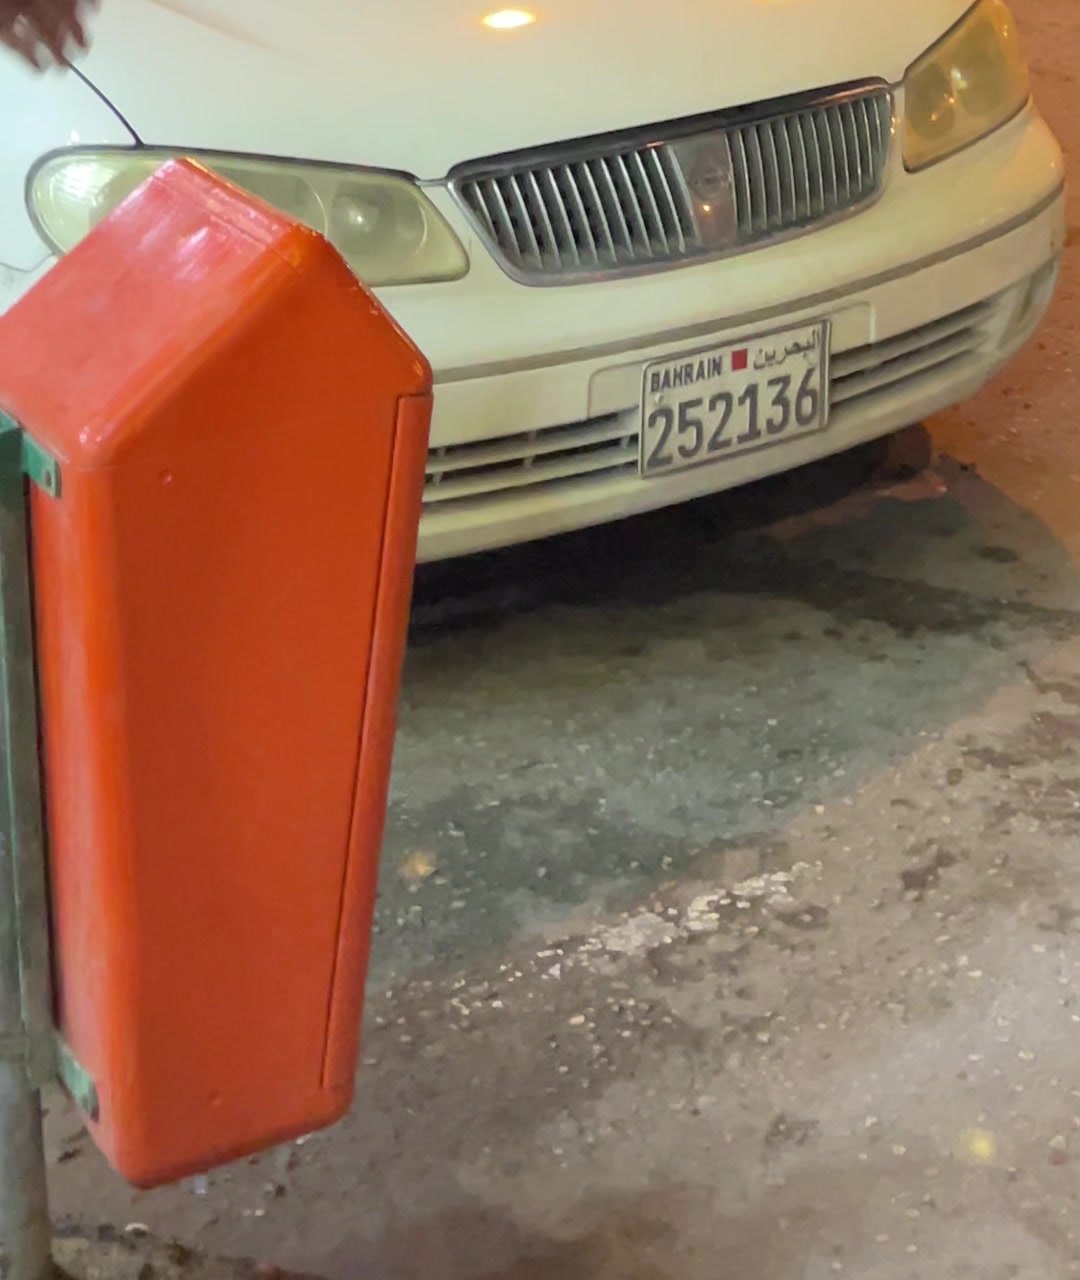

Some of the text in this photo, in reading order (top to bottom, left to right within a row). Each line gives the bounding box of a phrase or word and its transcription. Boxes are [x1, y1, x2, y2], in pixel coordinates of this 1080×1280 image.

[752, 329, 821, 370] البحرين
[650, 355, 723, 393] BAHRAIN
[646, 366, 819, 469] 252136
